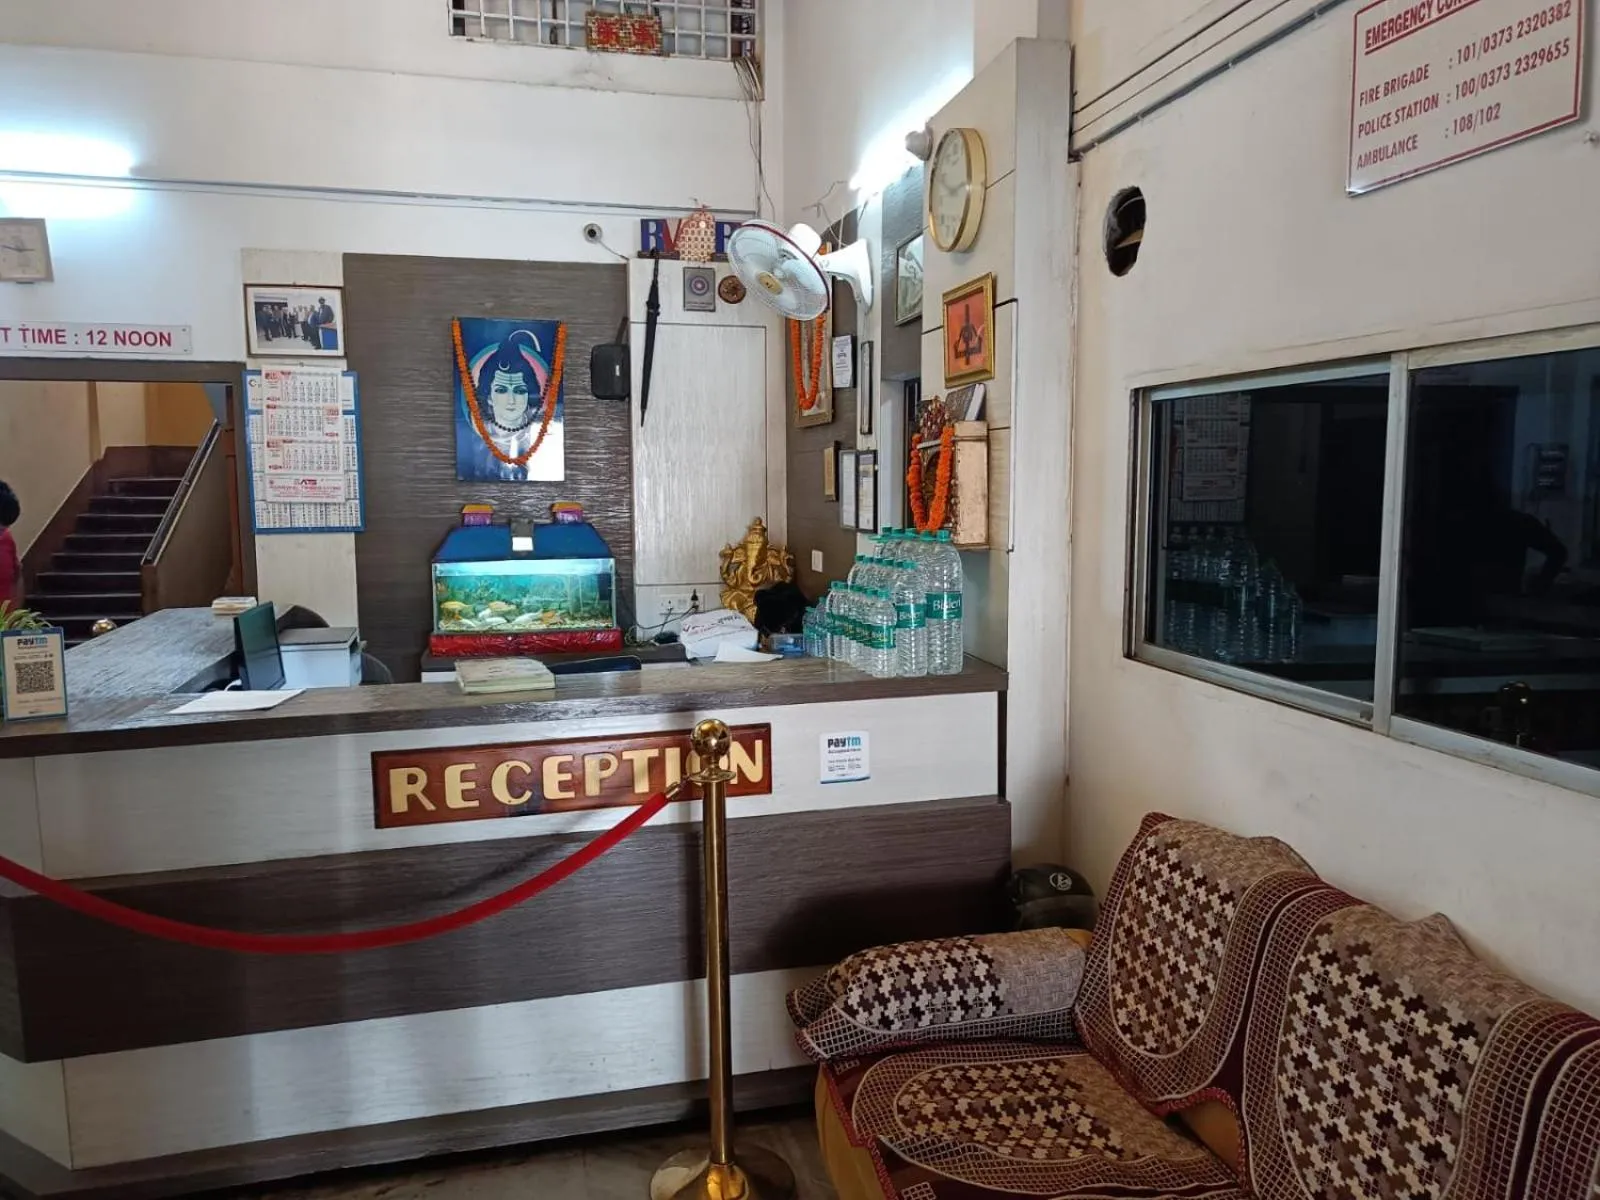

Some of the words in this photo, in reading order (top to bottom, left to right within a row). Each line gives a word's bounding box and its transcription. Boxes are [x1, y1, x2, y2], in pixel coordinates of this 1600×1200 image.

[1360, 85, 1381, 107] FIRE
[1383, 64, 1429, 98] BRIGADE
[1458, 26, 1513, 64] 101/0373
[1517, 0, 1571, 39] 2320382
[1366, 1, 1433, 49] EMERGENCY
[1358, 112, 1391, 139] POLICE
[1394, 93, 1439, 125] STATION
[1456, 62, 1511, 100] 100/0373
[1515, 37, 1570, 76] 2329655
[1357, 134, 1418, 170] AMBULANCE
[1454, 102, 1501, 135] 108/102
[19, 328, 66, 344] TIME
[87, 331, 107, 345] 12
[114, 331, 172, 346] NOON
